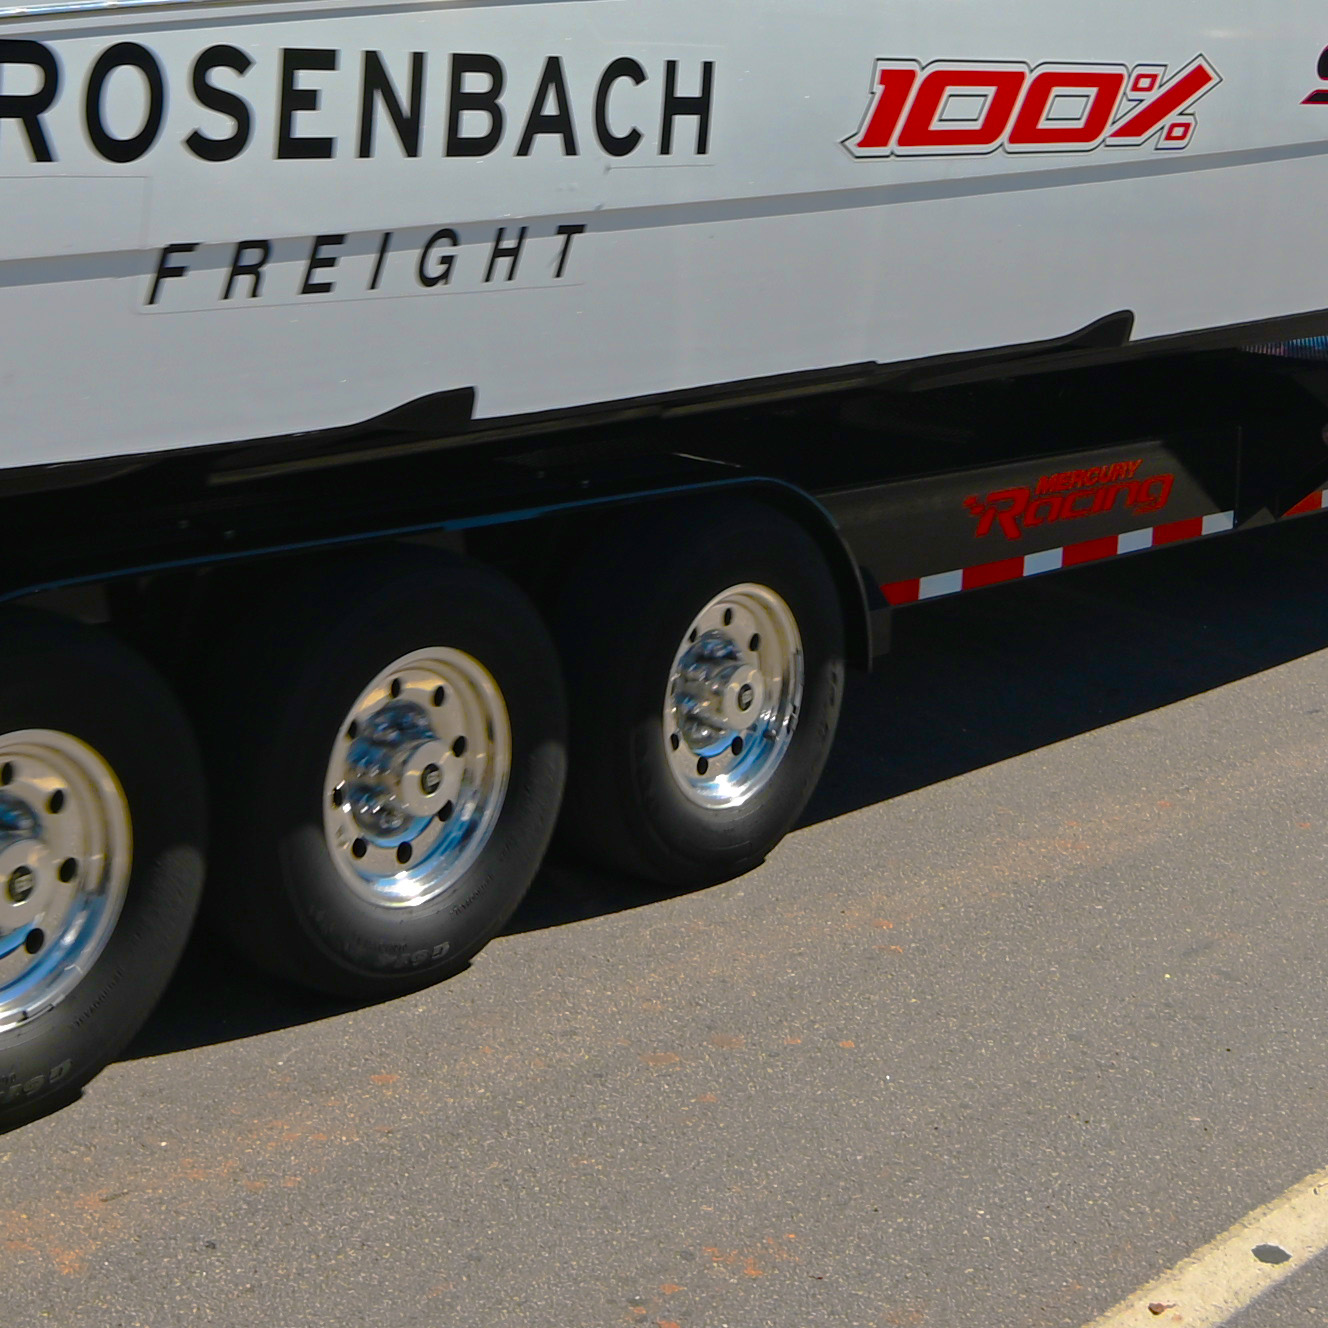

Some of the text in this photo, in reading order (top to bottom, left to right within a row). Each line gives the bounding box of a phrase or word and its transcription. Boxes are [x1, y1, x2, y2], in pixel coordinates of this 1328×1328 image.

[850, 58, 1218, 152] 100%
[146, 224, 587, 305] FREIGHT
[974, 474, 1175, 541] Racing
[1035, 459, 1144, 495] MERCURY
